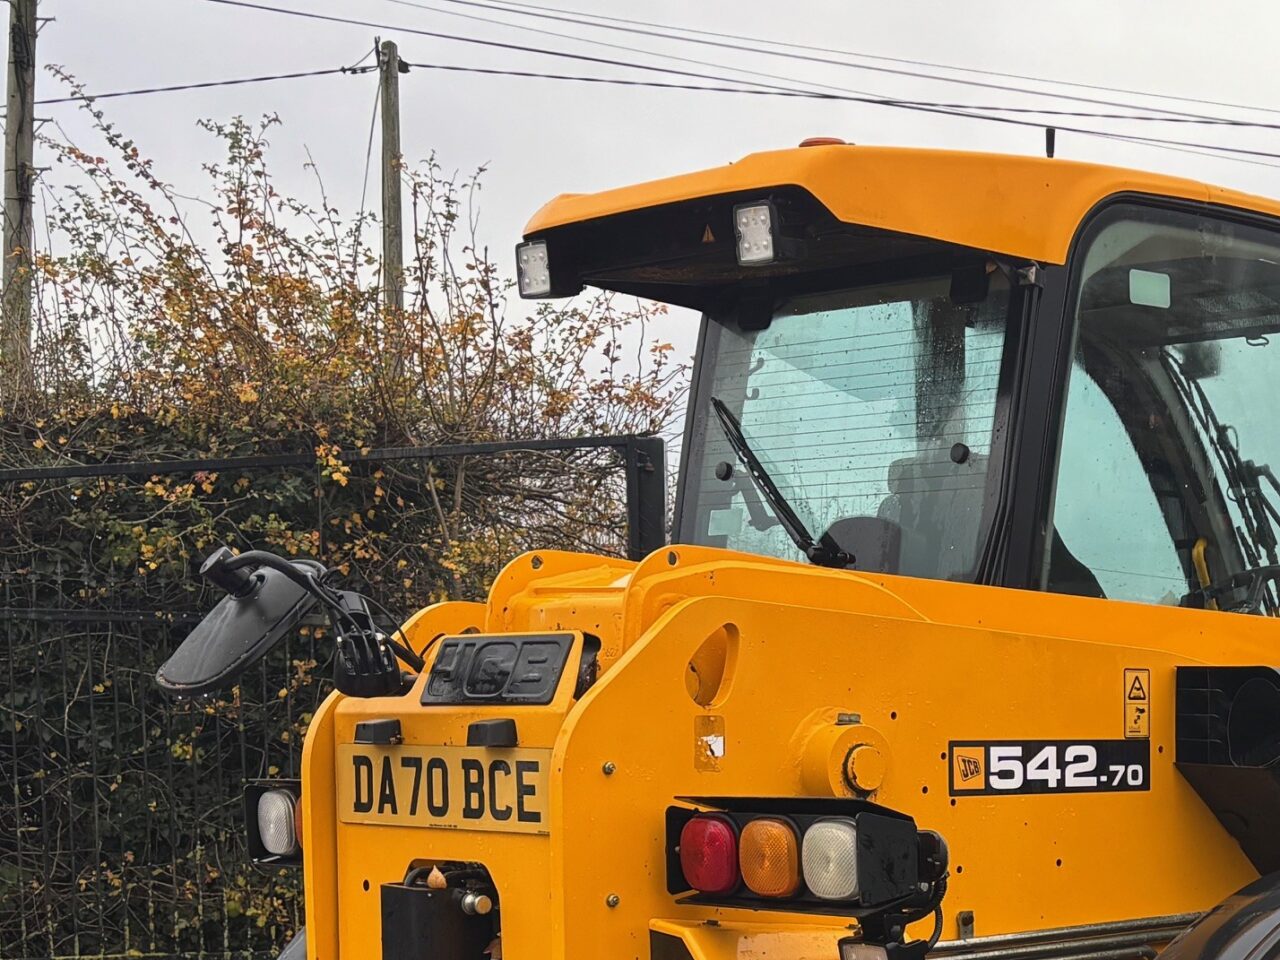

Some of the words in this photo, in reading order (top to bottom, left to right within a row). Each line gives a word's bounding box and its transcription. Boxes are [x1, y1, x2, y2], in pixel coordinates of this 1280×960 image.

[352, 754, 450, 817] DA70
[461, 758, 541, 823] BCE
[960, 757, 981, 779] JCB
